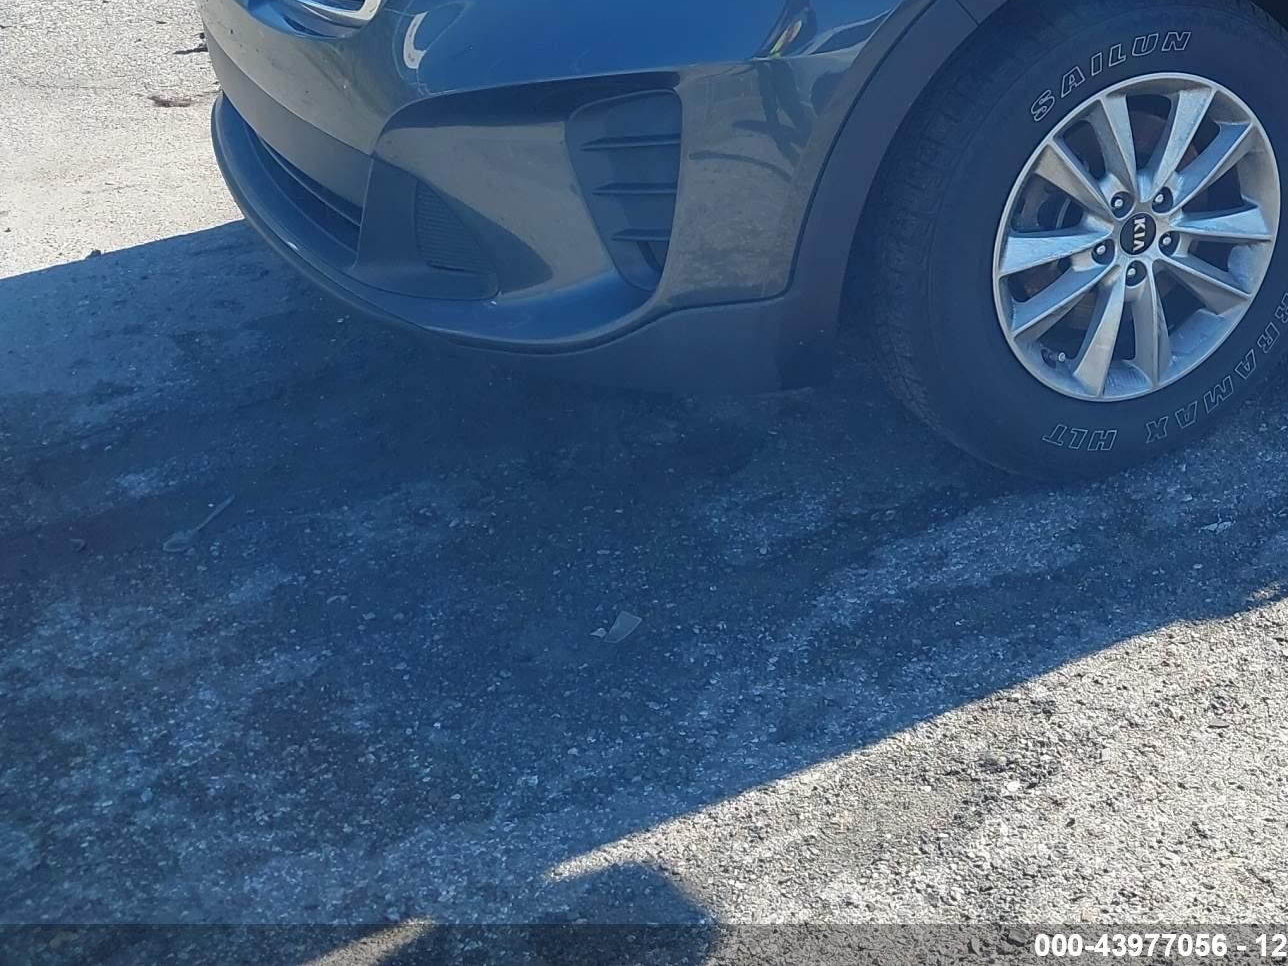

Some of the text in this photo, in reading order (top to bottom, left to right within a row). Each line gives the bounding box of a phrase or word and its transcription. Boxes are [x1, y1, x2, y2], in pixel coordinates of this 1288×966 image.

[1031, 32, 1192, 122] SAILUN
[1132, 217, 1146, 252] KIA
[1042, 424, 1117, 451] HLT
